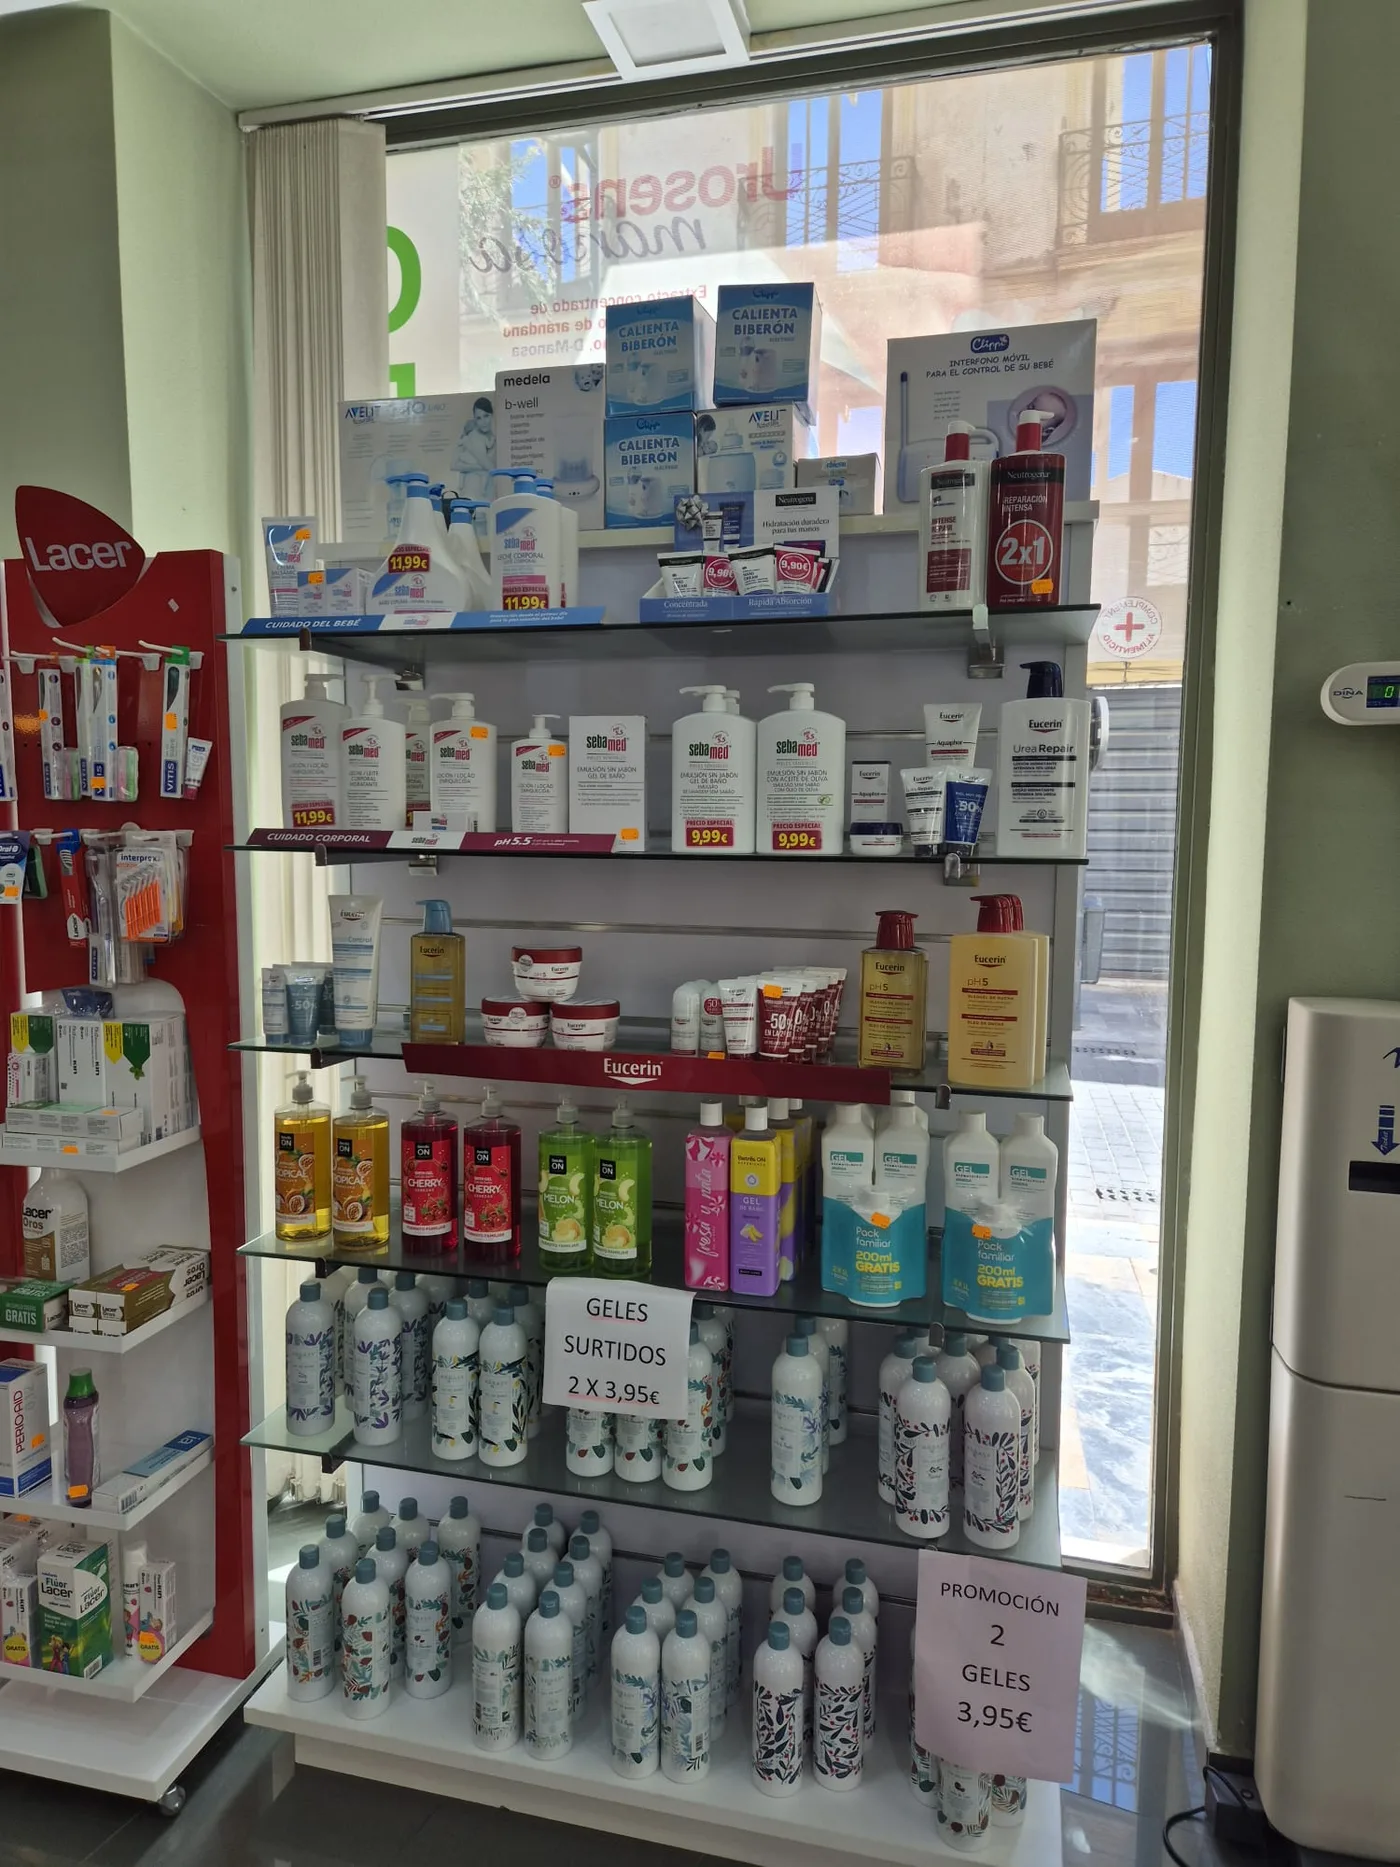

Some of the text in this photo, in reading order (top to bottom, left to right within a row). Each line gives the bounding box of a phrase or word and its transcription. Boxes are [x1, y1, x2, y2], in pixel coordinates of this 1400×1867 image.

[732, 307, 798, 321] CALIENTA
[618, 321, 680, 339] CALIENTA
[733, 319, 795, 336] BIBERÓN
[621, 333, 677, 353] BIBERÓN
[949, 352, 1030, 368] INTERFONO MÓVIL
[925, 358, 1054, 379] PARA EL CONTROL DE SU BEBÉ
[503, 373, 550, 387] medela
[504, 396, 539, 410] b-well
[618, 437, 680, 452] CALIENTA
[621, 450, 678, 466] BIBERÓN
[1007, 470, 1051, 483] Neutrogena
[777, 494, 815, 506] Neutrogena
[1003, 493, 1047, 504] REPARACIÓN
[1003, 503, 1033, 513] INTENSA
[762, 518, 830, 529] Hidratación duradera
[771, 525, 820, 535] para manos
[503, 537, 537, 552] sebamed
[1000, 536, 1045, 566] 2x1
[25, 536, 133, 573] Lacer
[514, 552, 544, 560] CORPORAL
[389, 555, 428, 571] 11,99€
[780, 559, 809, 572] 9,90€
[394, 585, 425, 599] sebamed
[663, 600, 708, 610] Concentrada
[775, 595, 812, 607] Absorción
[265, 617, 361, 629] CUIDADO DEL BEBÉ
[1332, 688, 1364, 698] DINA
[939, 712, 965, 721] Eucerin
[1028, 719, 1063, 730] Eucerin
[290, 732, 326, 749] sebamed
[586, 735, 627, 752] sebamed
[936, 739, 964, 748] Aquaphor
[348, 743, 380, 759] sebamed
[439, 746, 471, 761] sebamed
[688, 741, 729, 760] sebamed
[776, 739, 818, 758] sebamed
[521, 759, 551, 773] sebamed
[577, 765, 638, 773] EMULSIÓN JABÓN
[166, 761, 175, 793] VITIS
[608, 771, 626, 780] BAÑO
[680, 771, 739, 779] EMULSIÓN JABÓN
[766, 769, 828, 777] EMULSIÓN JABÓN
[810, 775, 829, 783] OLIVA
[858, 770, 881, 778] Eucerin
[709, 777, 728, 785] BAÑO
[293, 810, 333, 826] 11,99€
[706, 819, 733, 827] ESPECIAL
[772, 822, 821, 830] PRECIO ESPECIAL
[265, 832, 371, 844] CUIDADO CORPORAL
[411, 836, 439, 846] sebamed
[691, 829, 728, 845] 9,99€
[778, 832, 816, 850] 9,99€
[419, 946, 445, 955] Eucerin
[974, 954, 1004, 964] Eucerin
[875, 961, 905, 972] Eucerin
[603, 1058, 659, 1076] Eucerin
[280, 1138, 293, 1148] ON
[339, 1144, 351, 1154] ON
[416, 1147, 431, 1157] ON
[476, 1152, 489, 1162] ON
[831, 1153, 849, 1163] GEL
[884, 1154, 903, 1164] GEL
[551, 1162, 564, 1171] ON
[602, 1166, 614, 1175] ON
[955, 1164, 974, 1174] GEL
[1011, 1168, 1029, 1177] GEL
[407, 1177, 442, 1189] CHERRY
[468, 1184, 502, 1194] CHERRY
[543, 1194, 575, 1204] MELON
[742, 1196, 760, 1206] GEL
[22, 1206, 53, 1220] Lacer
[695, 1168, 719, 1258] fresa nata
[22, 1217, 44, 1230] Oros
[856, 1226, 879, 1239] Pack
[856, 1237, 892, 1249] familiar
[978, 1240, 1002, 1252] Pack
[856, 1250, 893, 1263] 200ml
[978, 1250, 1016, 1262] familiar
[186, 1262, 205, 1276] Oros
[855, 1261, 900, 1274] GRATIS
[977, 1264, 1016, 1276] 200ml
[183, 1270, 206, 1288] Lacer
[976, 1274, 1024, 1288] GRATIS
[74, 1302, 90, 1310] Lacer
[102, 1306, 118, 1314] Lacer
[586, 1297, 649, 1323] GELES
[5, 1309, 37, 1326] GRATIS
[564, 1335, 666, 1367] SURTIDOS
[568, 1376, 660, 1406] 2 X 3,95€
[45, 1576, 68, 1589] Flúor
[40, 1583, 73, 1599] Lacer
[83, 1586, 101, 1601] Flúor
[79, 1588, 105, 1614] Lacer
[940, 1582, 1060, 1617] PROMOCIÓN
[990, 1624, 1006, 1647] 2
[5, 1644, 26, 1652] GRATIS
[140, 1642, 160, 1651] GRATIS
[961, 1663, 1031, 1692] GELES
[957, 1701, 1033, 1734] 3,95€
